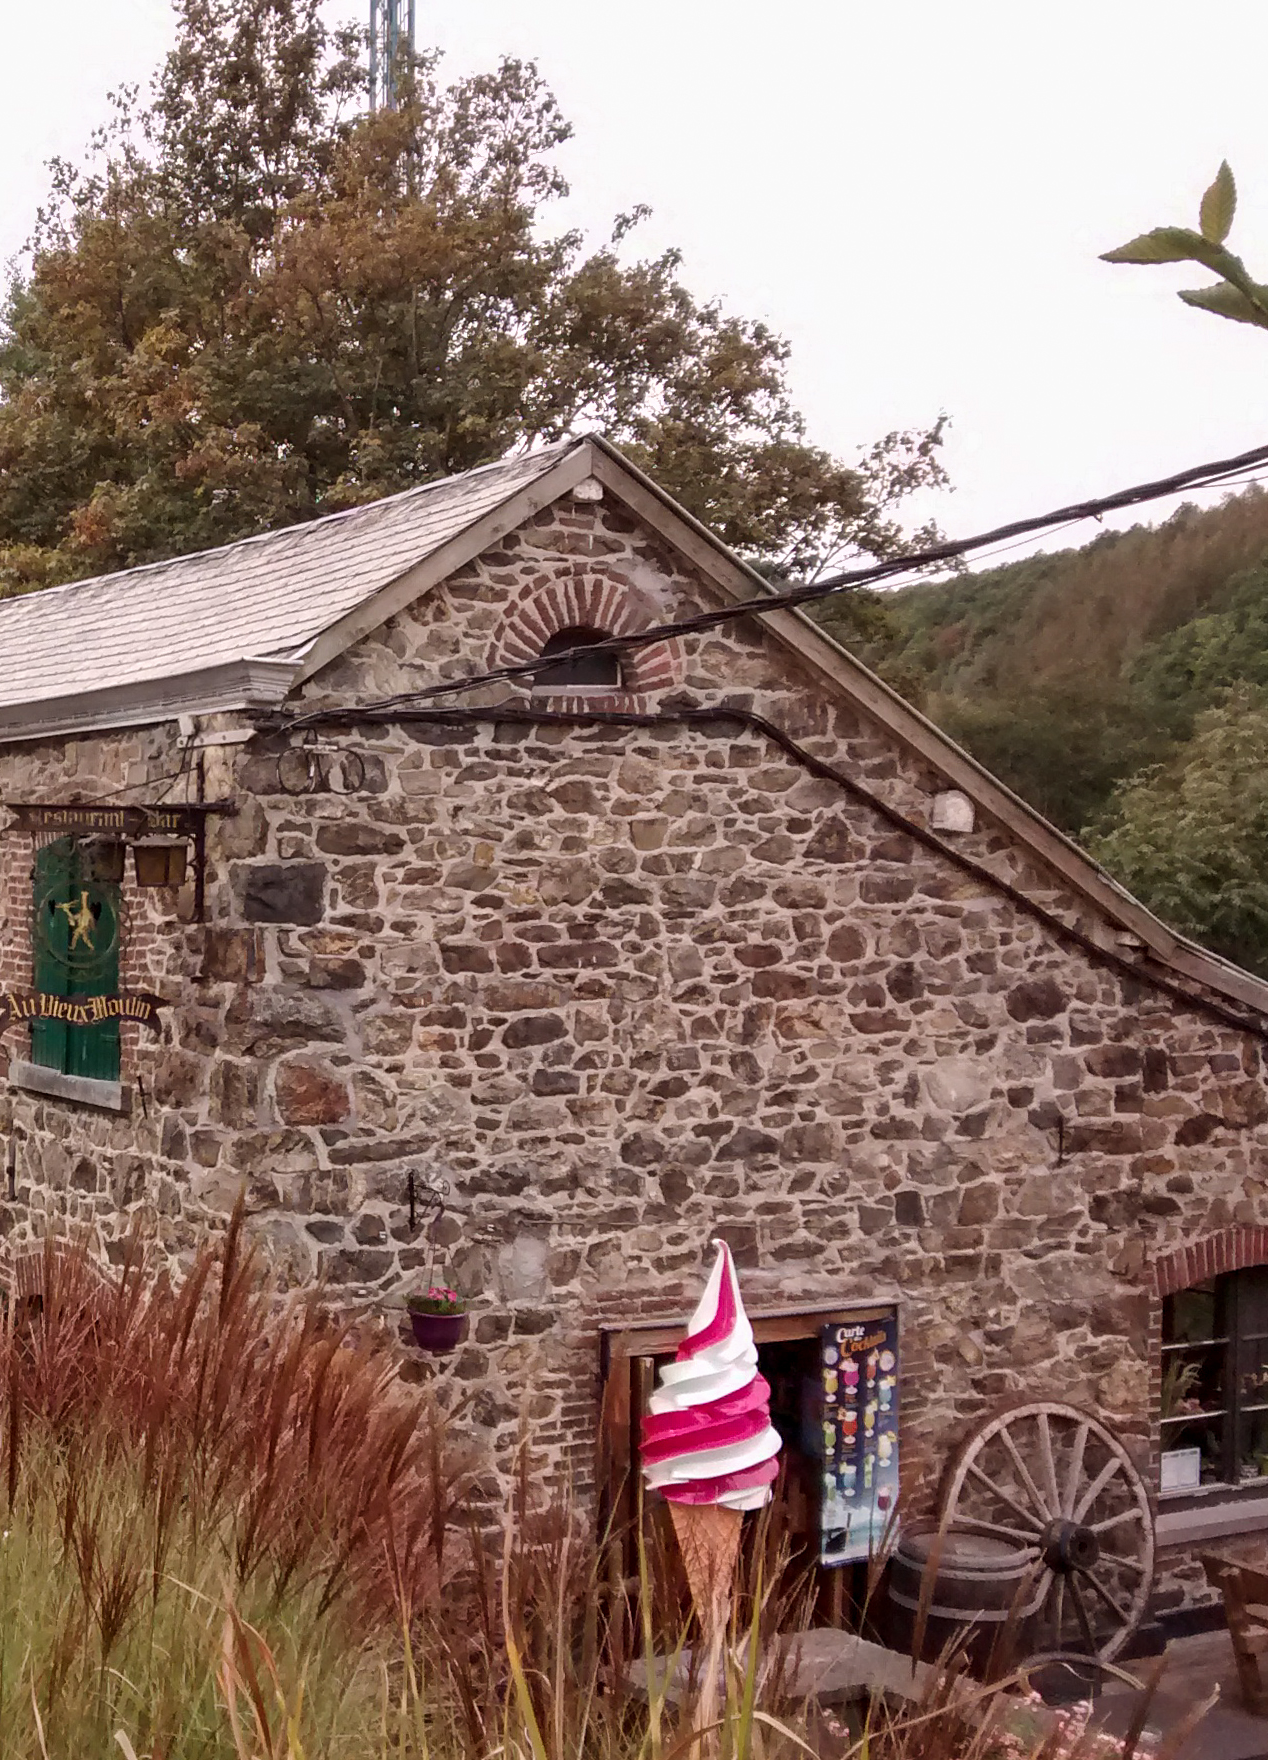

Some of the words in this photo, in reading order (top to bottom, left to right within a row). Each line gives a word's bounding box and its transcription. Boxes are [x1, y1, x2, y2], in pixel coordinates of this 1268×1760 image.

[5, 993, 37, 1021] Au
[39, 993, 89, 1023] Vieux
[87, 994, 152, 1024] Moulin
[836, 1325, 866, 1343] Carte
